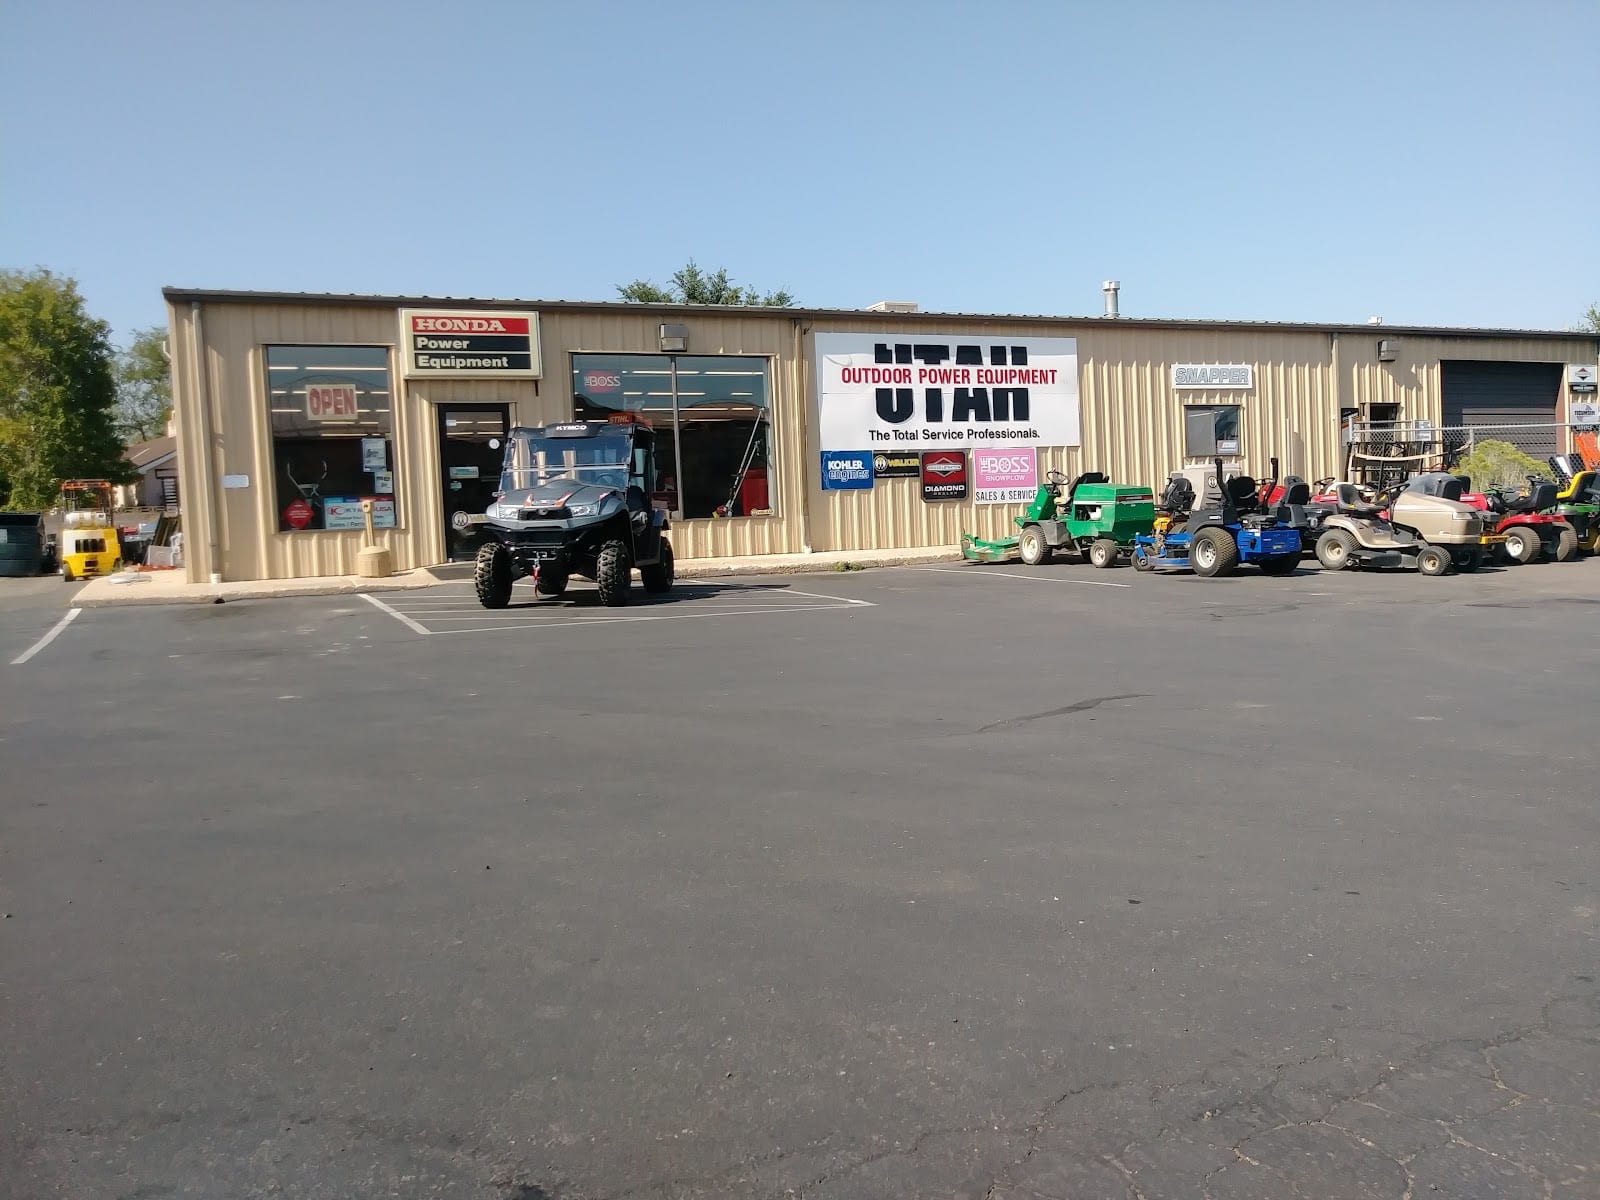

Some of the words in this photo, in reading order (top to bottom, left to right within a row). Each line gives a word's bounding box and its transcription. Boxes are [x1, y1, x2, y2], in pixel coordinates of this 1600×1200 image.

[415, 318, 506, 332] HONDA
[417, 337, 470, 349] Power
[418, 355, 509, 369] Equipment
[590, 376, 621, 387] BOSS
[841, 367, 912, 384] OUTDOOR
[919, 368, 970, 384] POWER
[977, 369, 1058, 385] EQUIPMENT
[1175, 367, 1249, 384] SNAPPER
[874, 343, 1030, 424] UTAH
[309, 387, 355, 416] OPEN
[609, 415, 630, 424] STIHL
[868, 429, 890, 441] The
[892, 429, 919, 441] Total
[922, 428, 964, 440] Service
[967, 427, 1040, 440] Professionals.
[827, 460, 864, 470] KOHLER
[980, 457, 988, 473] THE
[988, 456, 1030, 473] BOSS
[829, 470, 870, 483] engines
[985, 474, 1026, 482] SNOWPLOW
[975, 490, 998, 502] SALES
[1000, 490, 1006, 501] &
[1008, 489, 1037, 500] SERVICE
